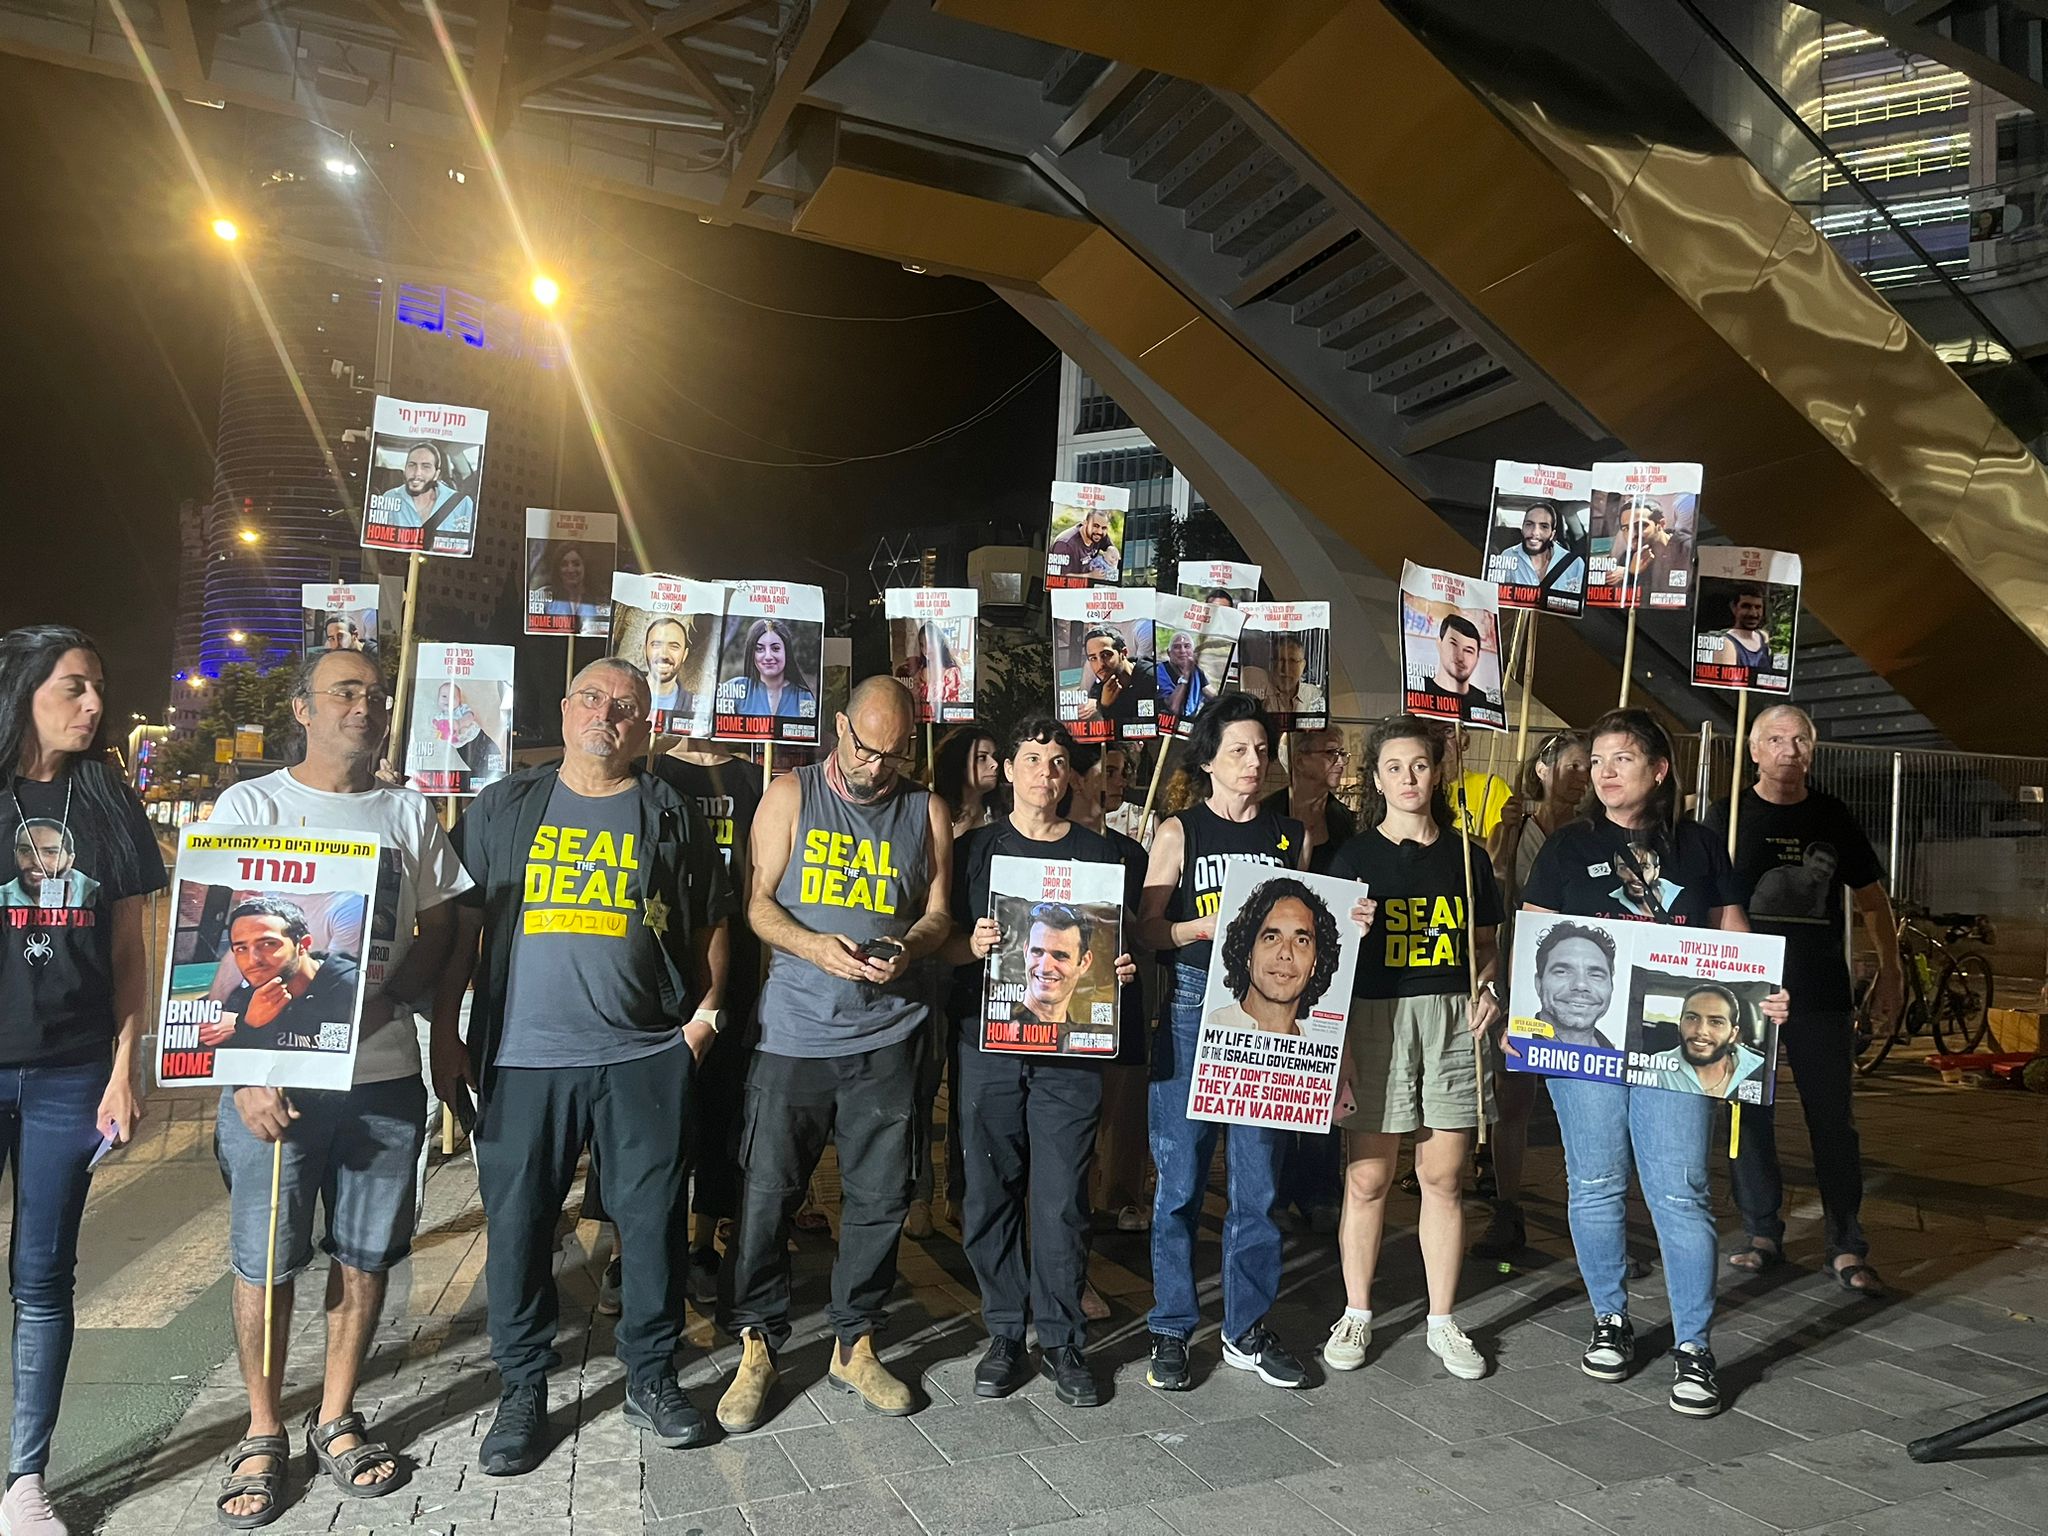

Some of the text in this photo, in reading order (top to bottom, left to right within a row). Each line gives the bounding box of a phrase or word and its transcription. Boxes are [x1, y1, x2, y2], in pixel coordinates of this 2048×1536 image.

[399, 408, 466, 427] מתן עדיין חי
[370, 494, 401, 512] BRING
[369, 509, 389, 525] HIM
[367, 524, 395, 541] HOME
[398, 528, 424, 544] NOW!
[1048, 553, 1070, 565] BRING
[1489, 554, 1518, 570] BRING
[1589, 557, 1617, 571] BRING
[1047, 564, 1061, 575] HIM
[1487, 569, 1505, 583] HIM
[1588, 571, 1606, 585] HIM
[529, 590, 553, 602] BRING
[749, 594, 789, 605] KARINA ARIEV
[1515, 586, 1541, 601] NOW!
[1587, 586, 1613, 601] HOME
[528, 602, 545, 614] HER
[1086, 602, 1106, 610] NIMROD
[528, 615, 551, 628] HOME
[1698, 635, 1724, 651] BRING
[1697, 649, 1714, 663] HIM
[1407, 662, 1435, 678] BRING
[1696, 664, 1719, 679] HOME
[1722, 666, 1749, 681] NOW!
[717, 683, 746, 699] BRING
[1407, 676, 1425, 692] HIM
[1059, 690, 1088, 705] BRING
[1407, 692, 1435, 709] HOME
[716, 699, 735, 714] HER
[1060, 705, 1079, 720] HIM
[716, 717, 743, 732] HOME
[745, 717, 774, 733] NOW!
[1065, 720, 1087, 736] OME
[1089, 720, 1116, 736] NOW!
[409, 741, 434, 756] RING
[432, 772, 461, 787] NOW!
[192, 835, 370, 857] מה עשינו היום כדי להחזיר את
[528, 825, 639, 870] SEAL
[803, 829, 898, 878] SEAL
[238, 857, 317, 884] נמרוד
[574, 860, 596, 872] THE
[843, 866, 860, 878] THE
[1044, 866, 1071, 876] דרור אור
[1593, 863, 1609, 874] 372
[523, 863, 637, 910] DEAL
[800, 866, 895, 915] DEAL
[1042, 877, 1071, 888] DROR OR
[1057, 889, 1071, 900] (49)
[1424, 927, 1440, 937] THE
[1679, 940, 1739, 959] מתן צנגאוקר
[1650, 952, 1766, 975] MATAN ZANGAUKER
[1696, 968, 1715, 978] (24)
[989, 983, 1025, 1001] BRING
[166, 1000, 222, 1024] BRING
[988, 1001, 1010, 1020] HIM
[164, 1025, 199, 1050] HIM
[987, 1023, 1058, 1043] HOME NOW!
[1204, 1029, 1339, 1059] MY LIFE IS IN THE HANDS
[162, 1052, 214, 1077] HOME
[1201, 1046, 1336, 1075] OF THE ISRAELI GOVERNMENT
[1528, 1046, 1579, 1072] BRING
[1628, 1051, 1679, 1071] BRING
[1199, 1063, 1332, 1091] IF THEY DON'T SIGN A DEAL
[1627, 1069, 1658, 1087] HIM
[1198, 1078, 1331, 1107] THEY ARE SIGNING MY
[1193, 1095, 1329, 1126] DEATH WARRANT!
